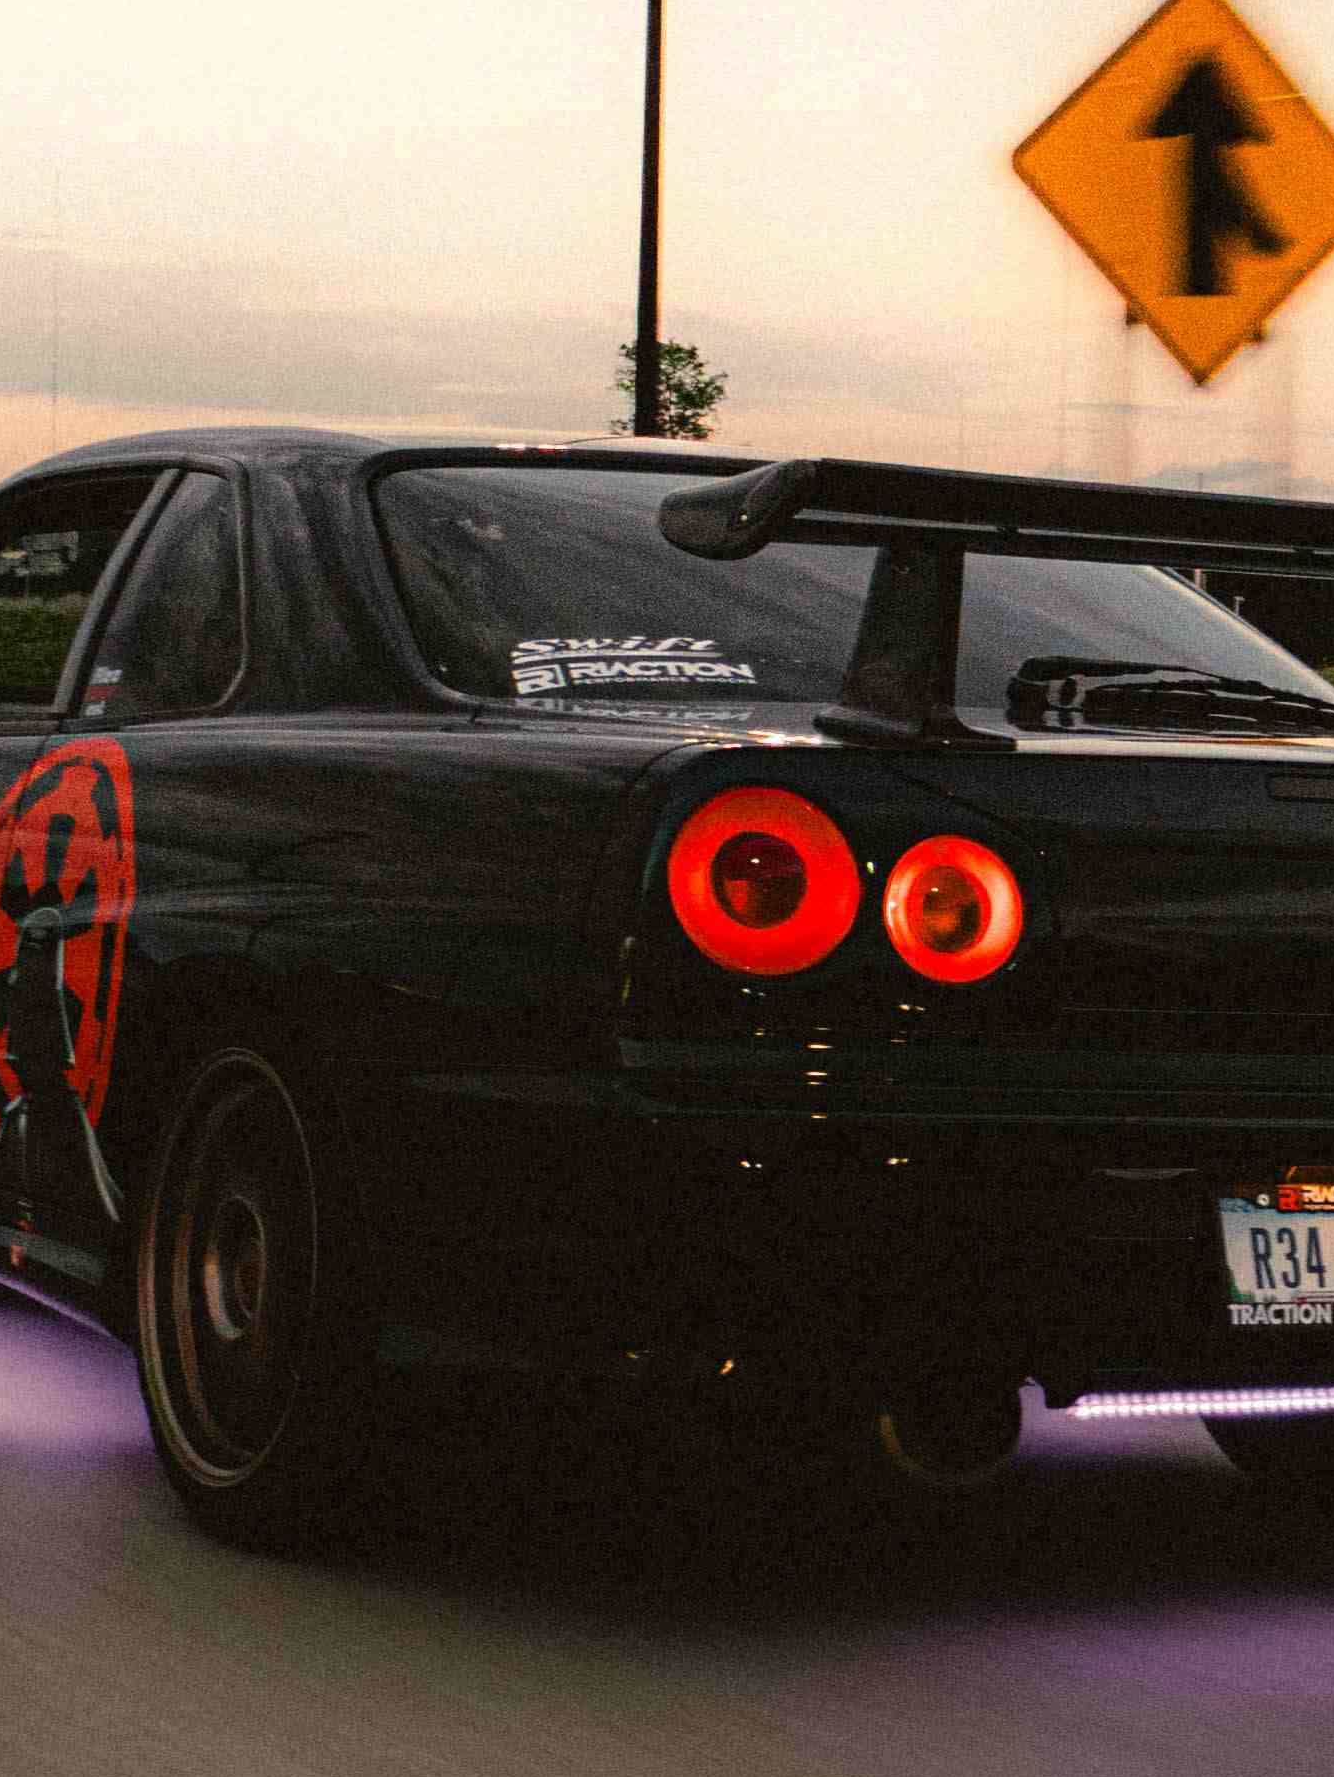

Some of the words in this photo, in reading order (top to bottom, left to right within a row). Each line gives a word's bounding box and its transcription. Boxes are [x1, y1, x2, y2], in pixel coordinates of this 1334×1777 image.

[568, 661, 755, 679] RIACTION
[1250, 1226, 1327, 1290] R34
[1228, 1302, 1332, 1325] TRACTION
